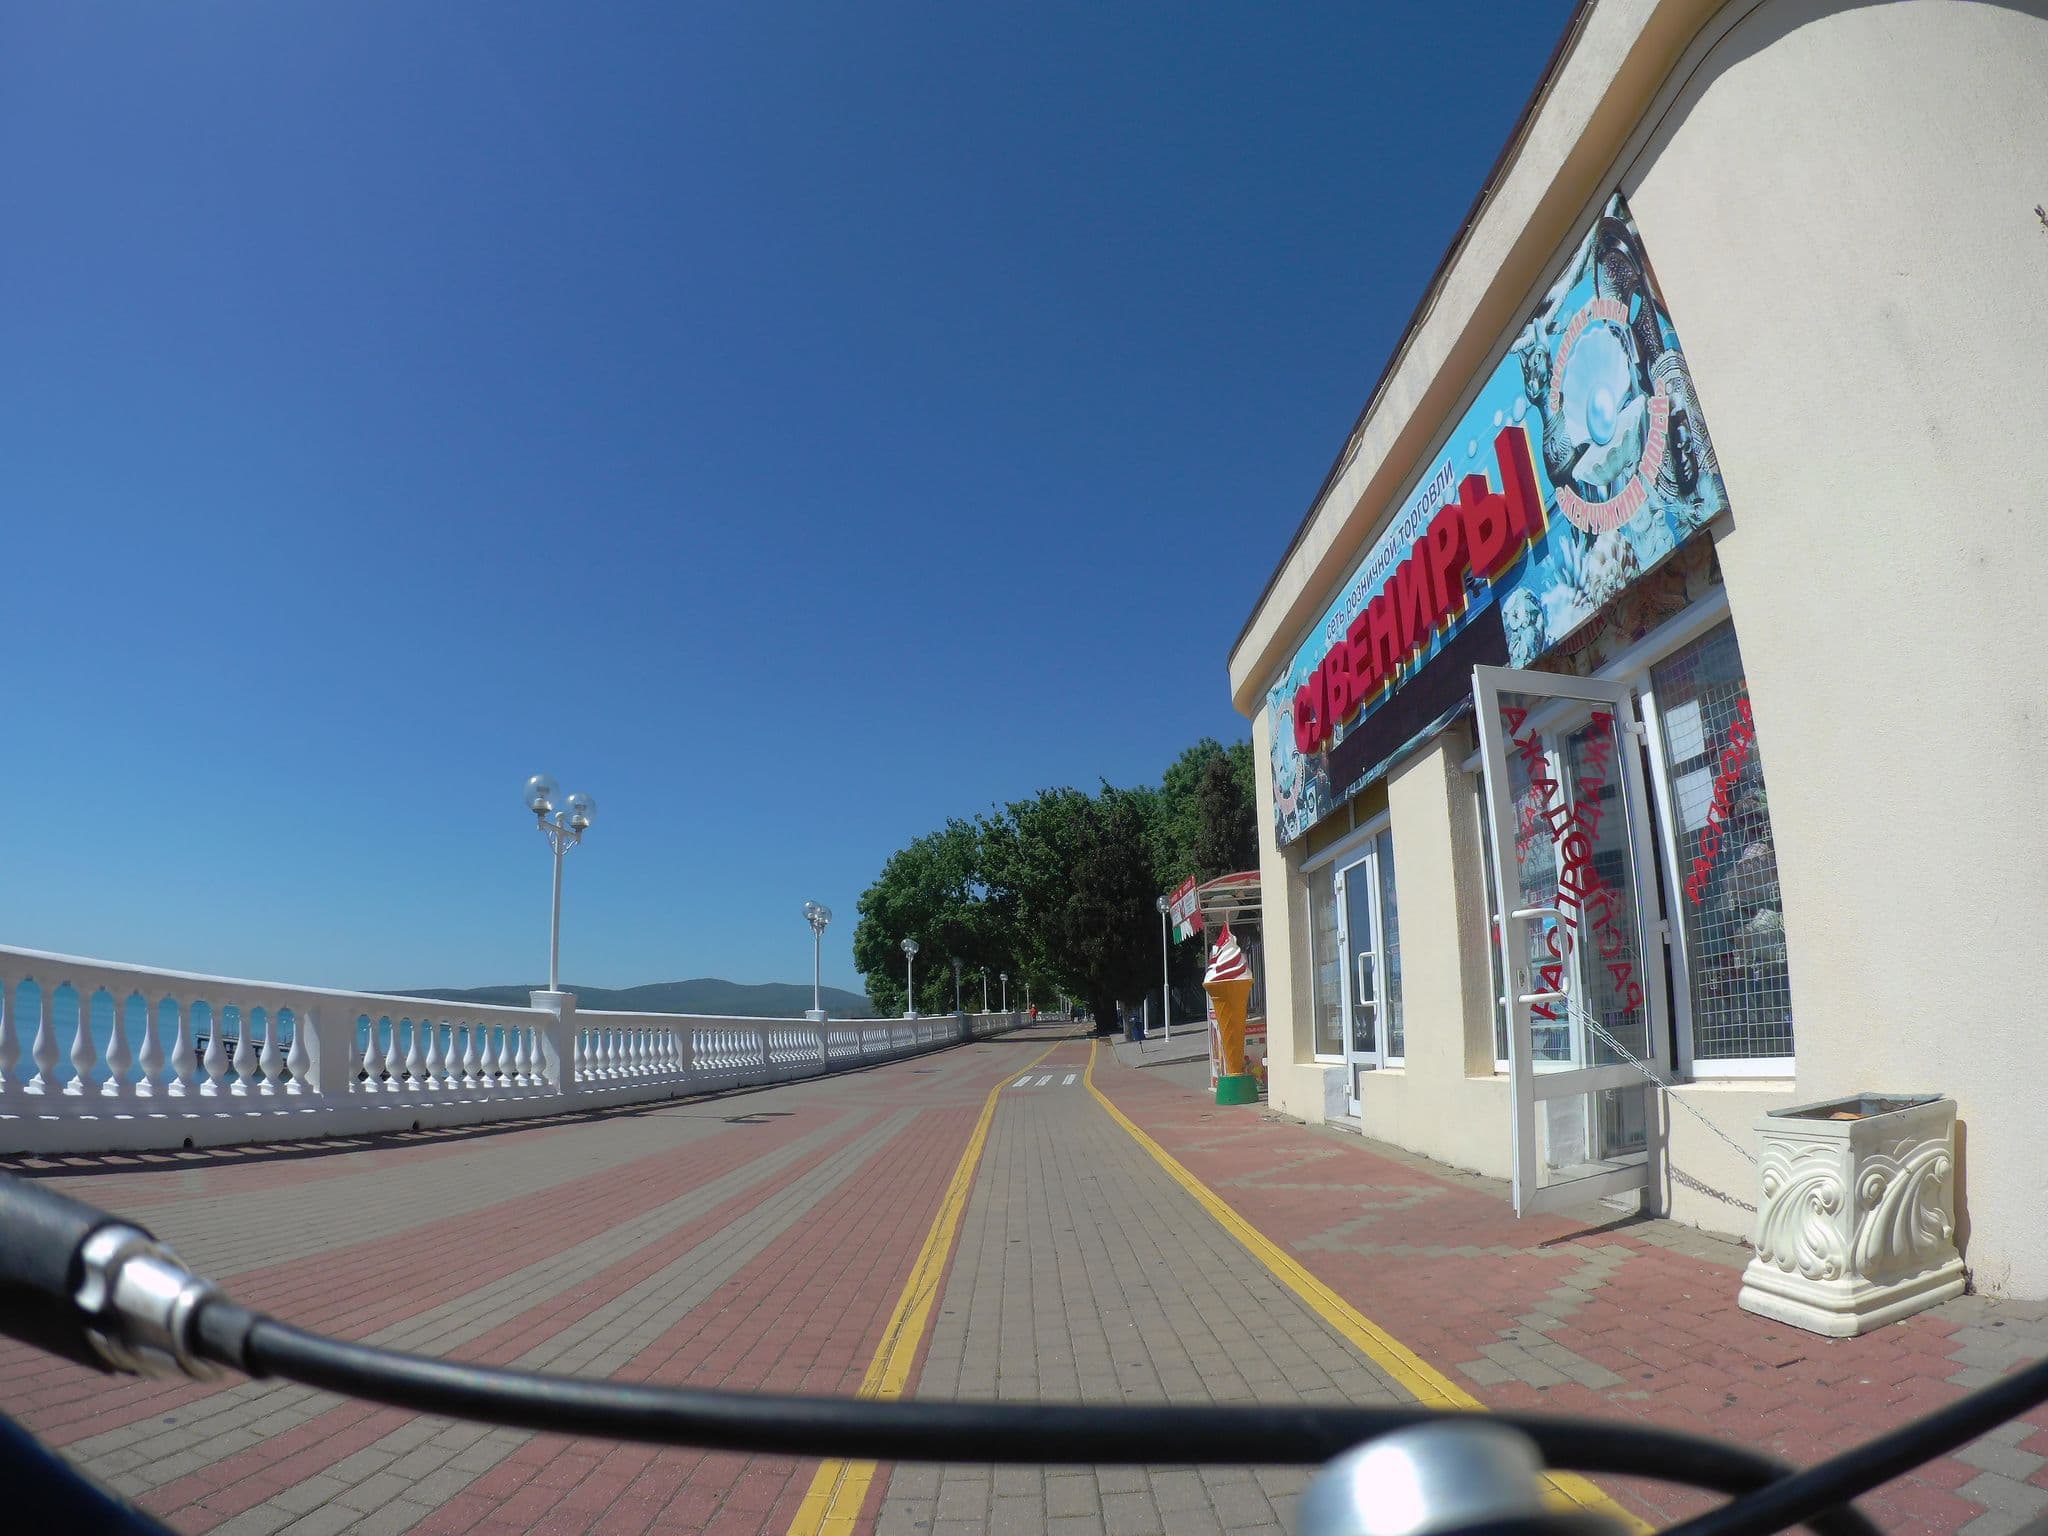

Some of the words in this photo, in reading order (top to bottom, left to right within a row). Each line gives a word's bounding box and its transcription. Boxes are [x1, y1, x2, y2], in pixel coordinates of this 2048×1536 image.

[1294, 426, 1547, 753] СУВЕНИРЫ
[1327, 609, 1345, 639] сеть
[1345, 536, 1397, 620] розничной
[1399, 460, 1454, 546] торговли
